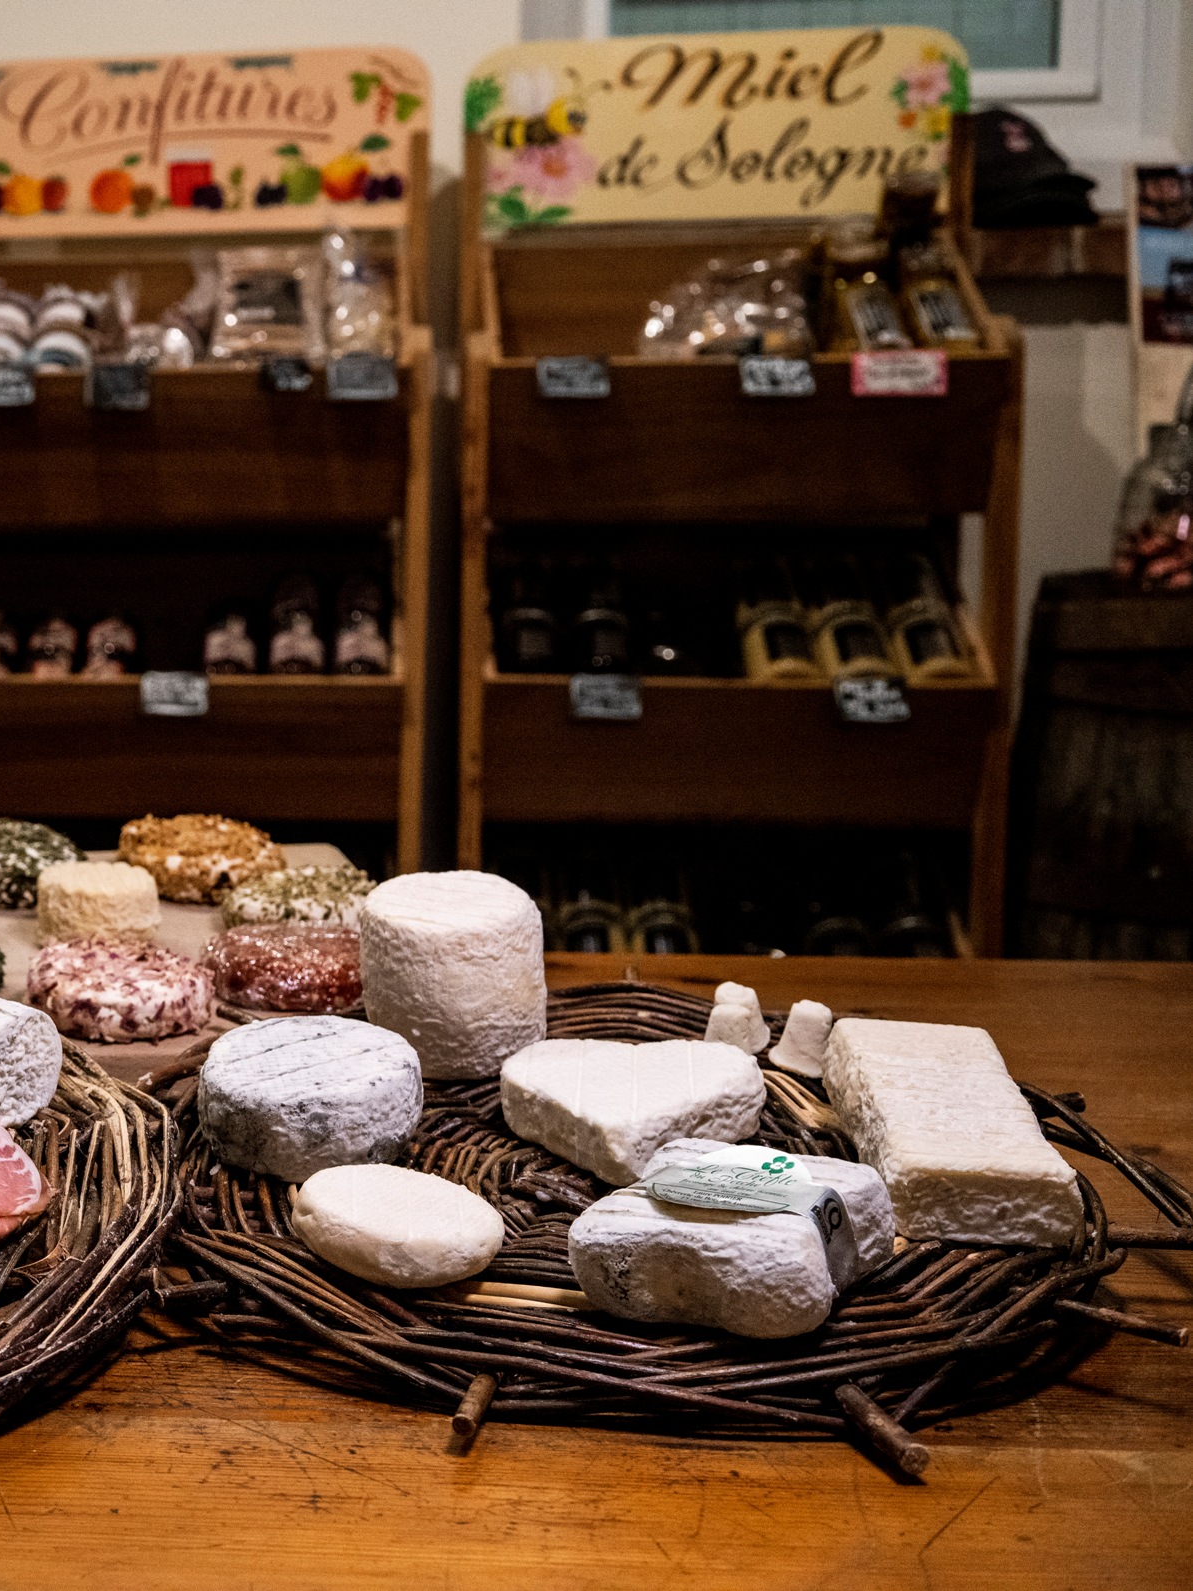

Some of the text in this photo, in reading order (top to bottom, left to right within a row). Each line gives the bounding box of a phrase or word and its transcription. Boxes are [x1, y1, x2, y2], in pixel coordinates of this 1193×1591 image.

[620, 27, 885, 112] Miel
[597, 133, 658, 190] de
[676, 115, 929, 208] Sologne
